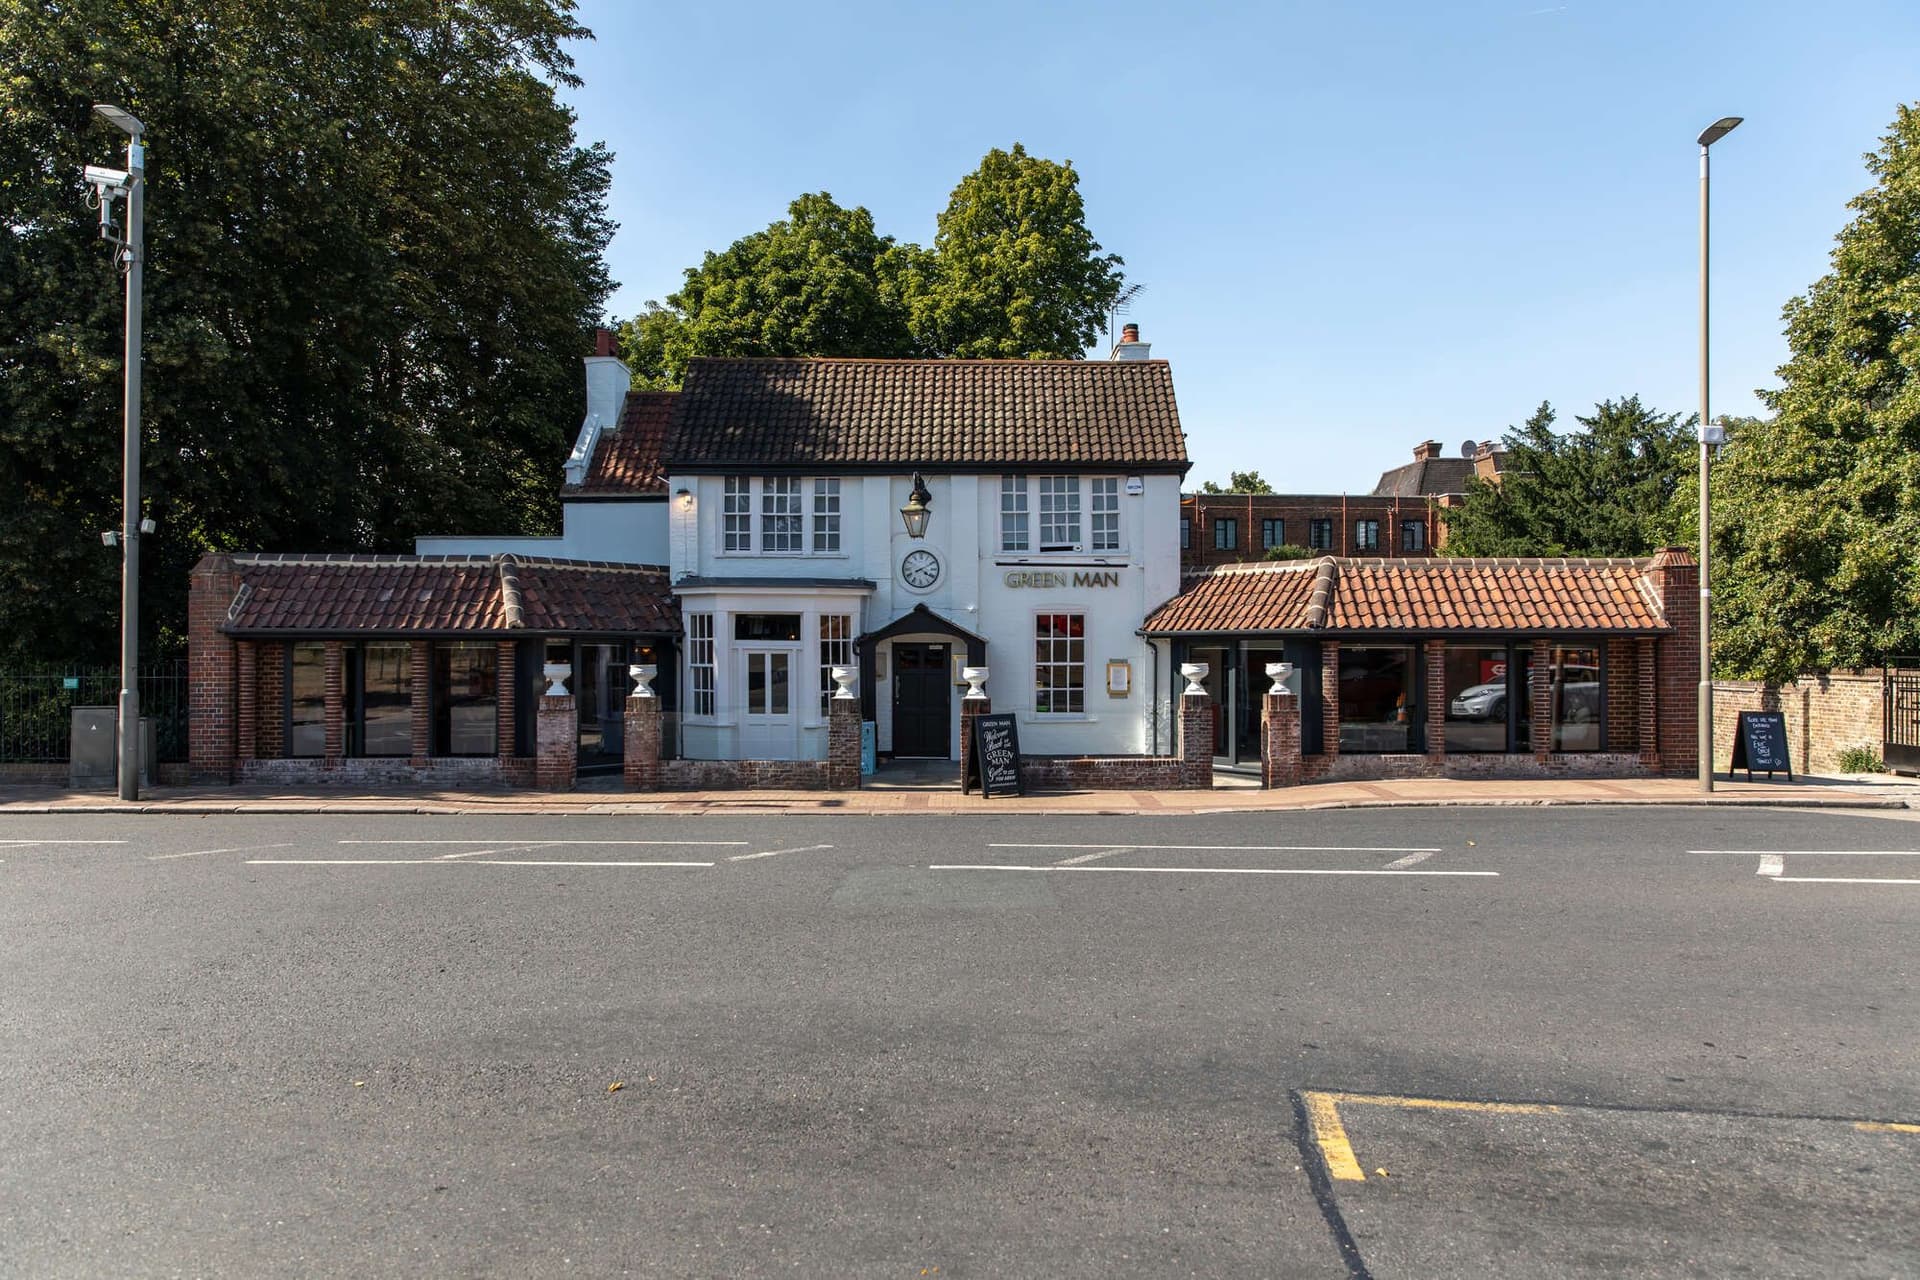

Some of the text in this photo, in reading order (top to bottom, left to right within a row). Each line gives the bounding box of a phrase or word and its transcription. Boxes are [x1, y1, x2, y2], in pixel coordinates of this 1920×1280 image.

[1004, 571, 1119, 588] GREEN MAN
[986, 749, 1014, 760] GREEN
[991, 757, 1010, 765] MAN
